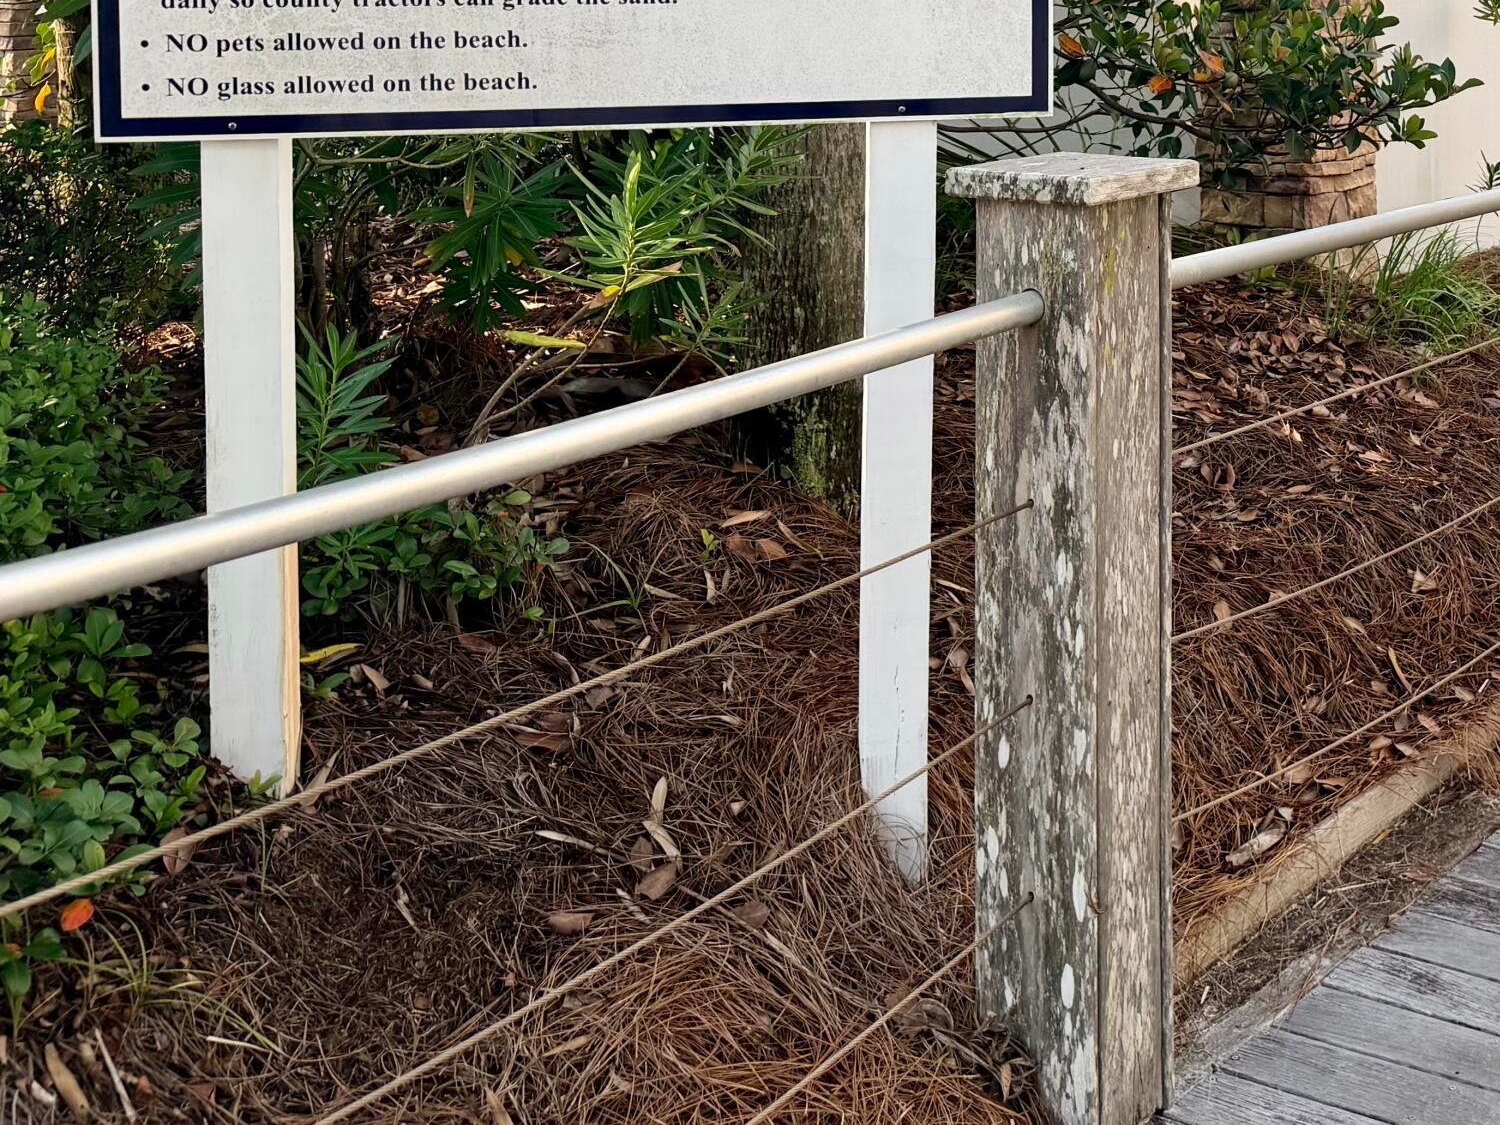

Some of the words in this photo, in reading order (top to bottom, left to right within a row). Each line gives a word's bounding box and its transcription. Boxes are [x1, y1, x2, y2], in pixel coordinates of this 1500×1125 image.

[166, 33, 208, 53] NO
[216, 34, 265, 58] pets
[273, 31, 365, 52] allowed
[372, 36, 401, 50] on
[409, 30, 446, 50] the
[454, 29, 528, 49] beach.
[167, 77, 209, 97] NO
[217, 76, 275, 102] glass
[283, 74, 374, 95] allowed
[383, 78, 411, 93] on
[419, 73, 456, 92] the
[463, 71, 538, 91] beach.
